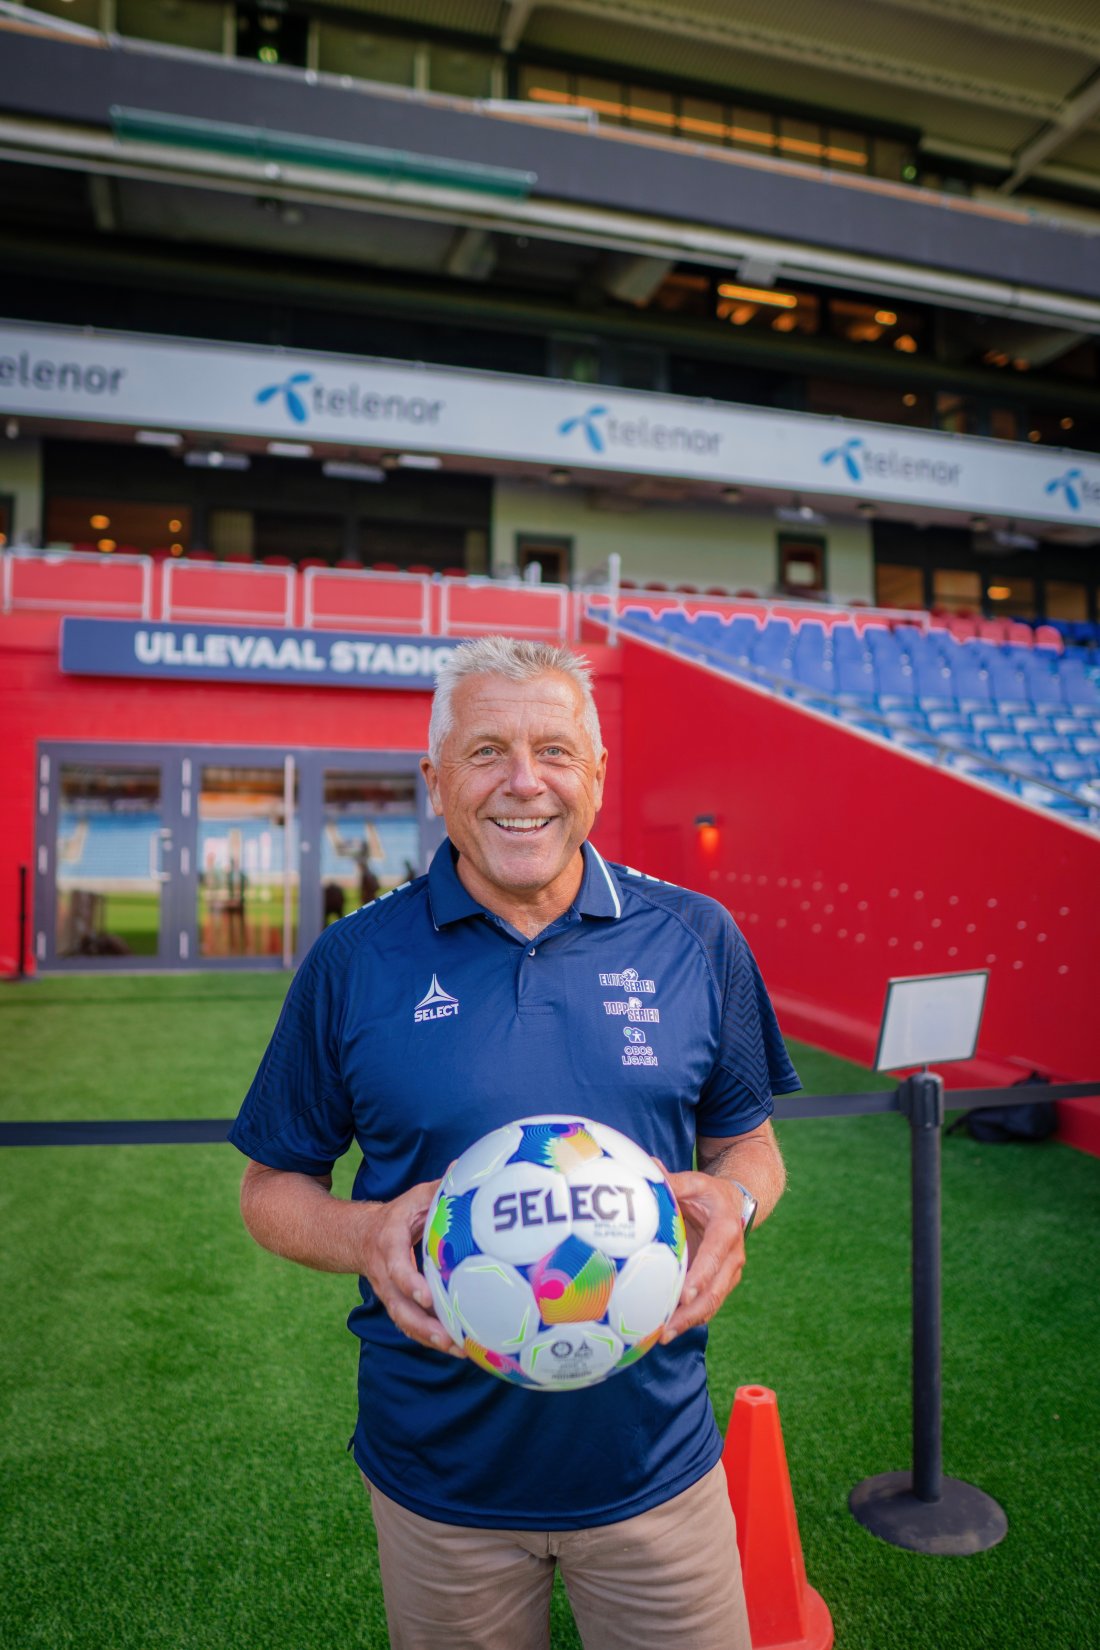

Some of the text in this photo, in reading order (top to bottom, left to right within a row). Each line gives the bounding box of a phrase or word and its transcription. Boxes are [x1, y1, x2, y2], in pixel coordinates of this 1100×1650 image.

[312, 384, 444, 424] telenor
[608, 417, 722, 454] telenor
[862, 449, 962, 486] telenor
[135, 631, 324, 670] ULLEVAAL
[599, 974, 626, 987] ELITE
[624, 980, 656, 993] SERIEN
[414, 1004, 460, 1022] SELECT
[603, 1002, 629, 1015] TOPP
[628, 1009, 659, 1023] SERIEN
[624, 1046, 653, 1055] OBOS
[622, 1055, 658, 1066] LIGAEN
[494, 1184, 636, 1232] SELECT
